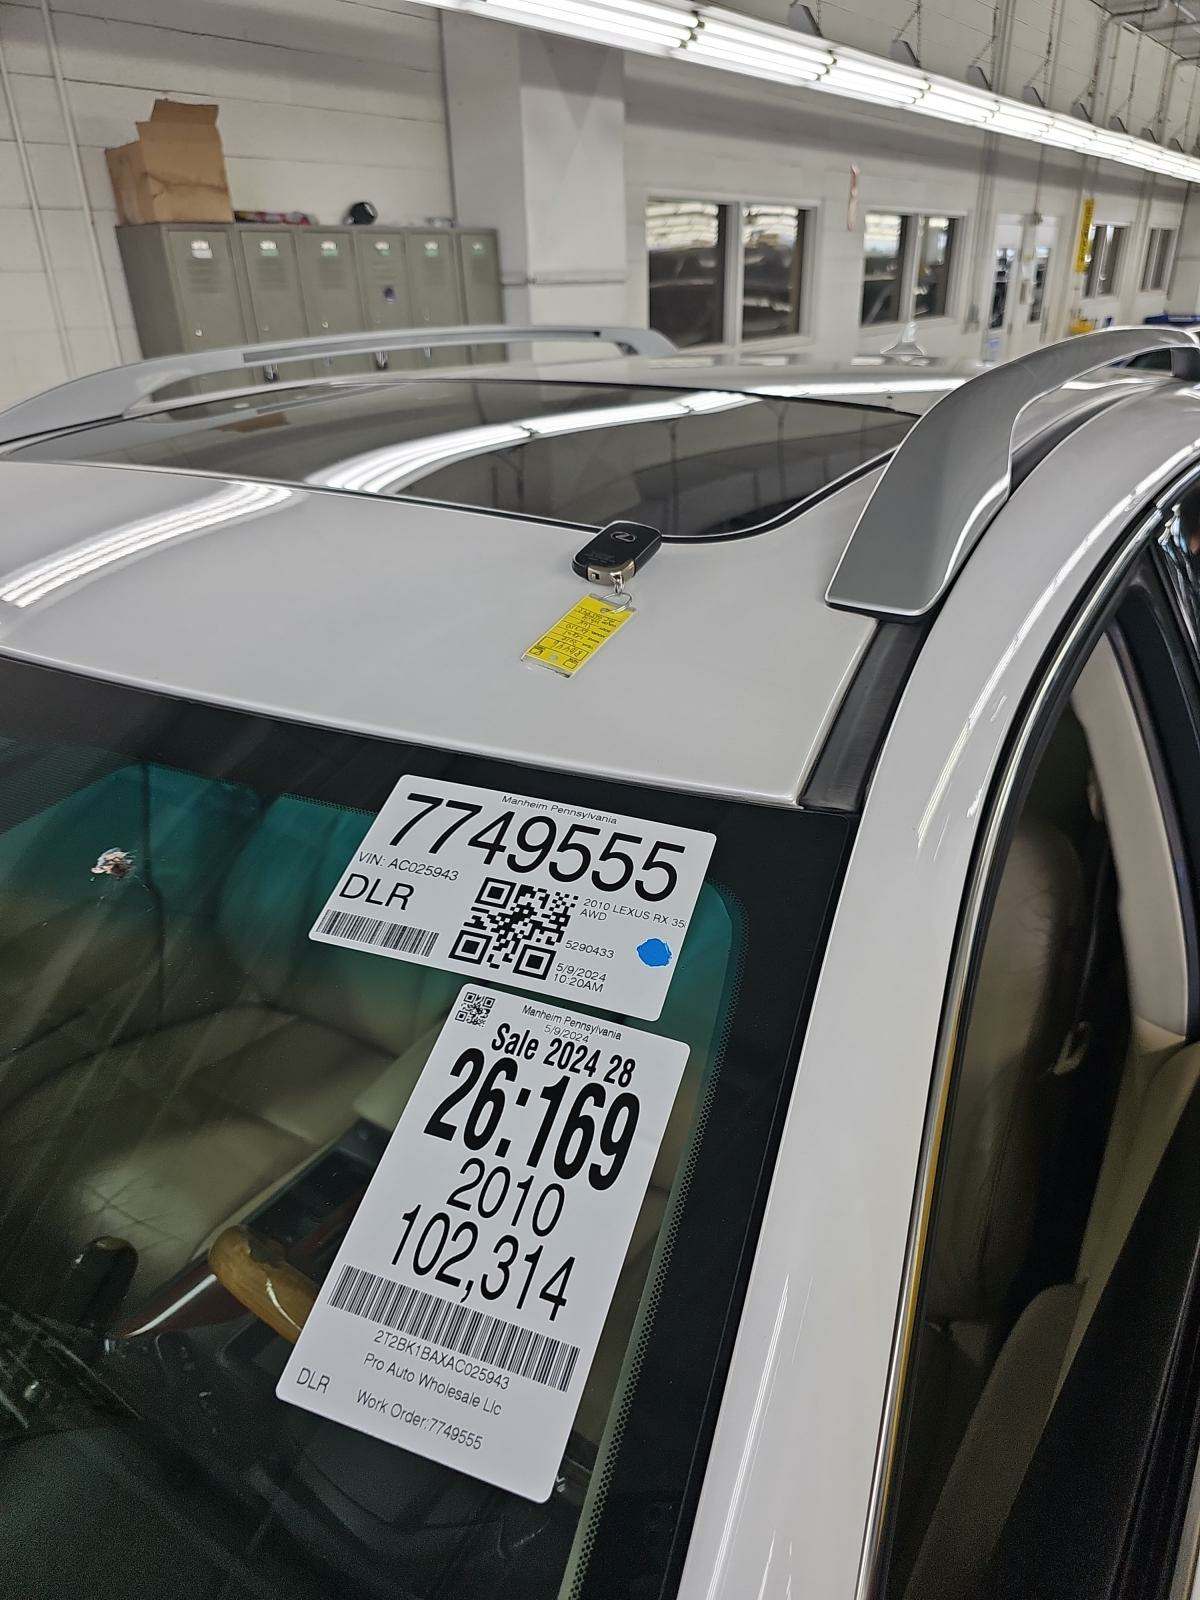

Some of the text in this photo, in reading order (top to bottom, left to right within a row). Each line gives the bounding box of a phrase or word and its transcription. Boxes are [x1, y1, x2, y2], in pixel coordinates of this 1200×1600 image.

[502, 795, 618, 825] Manheim Pennsylvania
[389, 792, 686, 902] 7749555
[359, 851, 459, 881] VIN: AC025943
[339, 873, 415, 911] DLR
[580, 908, 607, 921] AWD
[583, 898, 688, 929] 2010 LEXUS RX 35
[565, 940, 615, 959] 5290433
[553, 974, 604, 993] 10:20AM
[556, 963, 607, 983] 5/9/2024
[522, 1004, 622, 1041] Manheim Pennsylvania
[544, 1025, 590, 1043] 5/9/2024
[491, 1022, 636, 1088] Sale 2024 28
[424, 1048, 640, 1191] 26:169
[446, 1158, 565, 1237] 2010
[391, 1204, 576, 1322] 102,314
[374, 1329, 510, 1390] 2T2BK1BAXAC025943
[296, 1367, 331, 1394] DLR
[364, 1352, 385, 1371] Pro
[386, 1361, 415, 1382] Auto
[419, 1372, 481, 1408] Wholesale
[356, 1389, 388, 1414] Work
